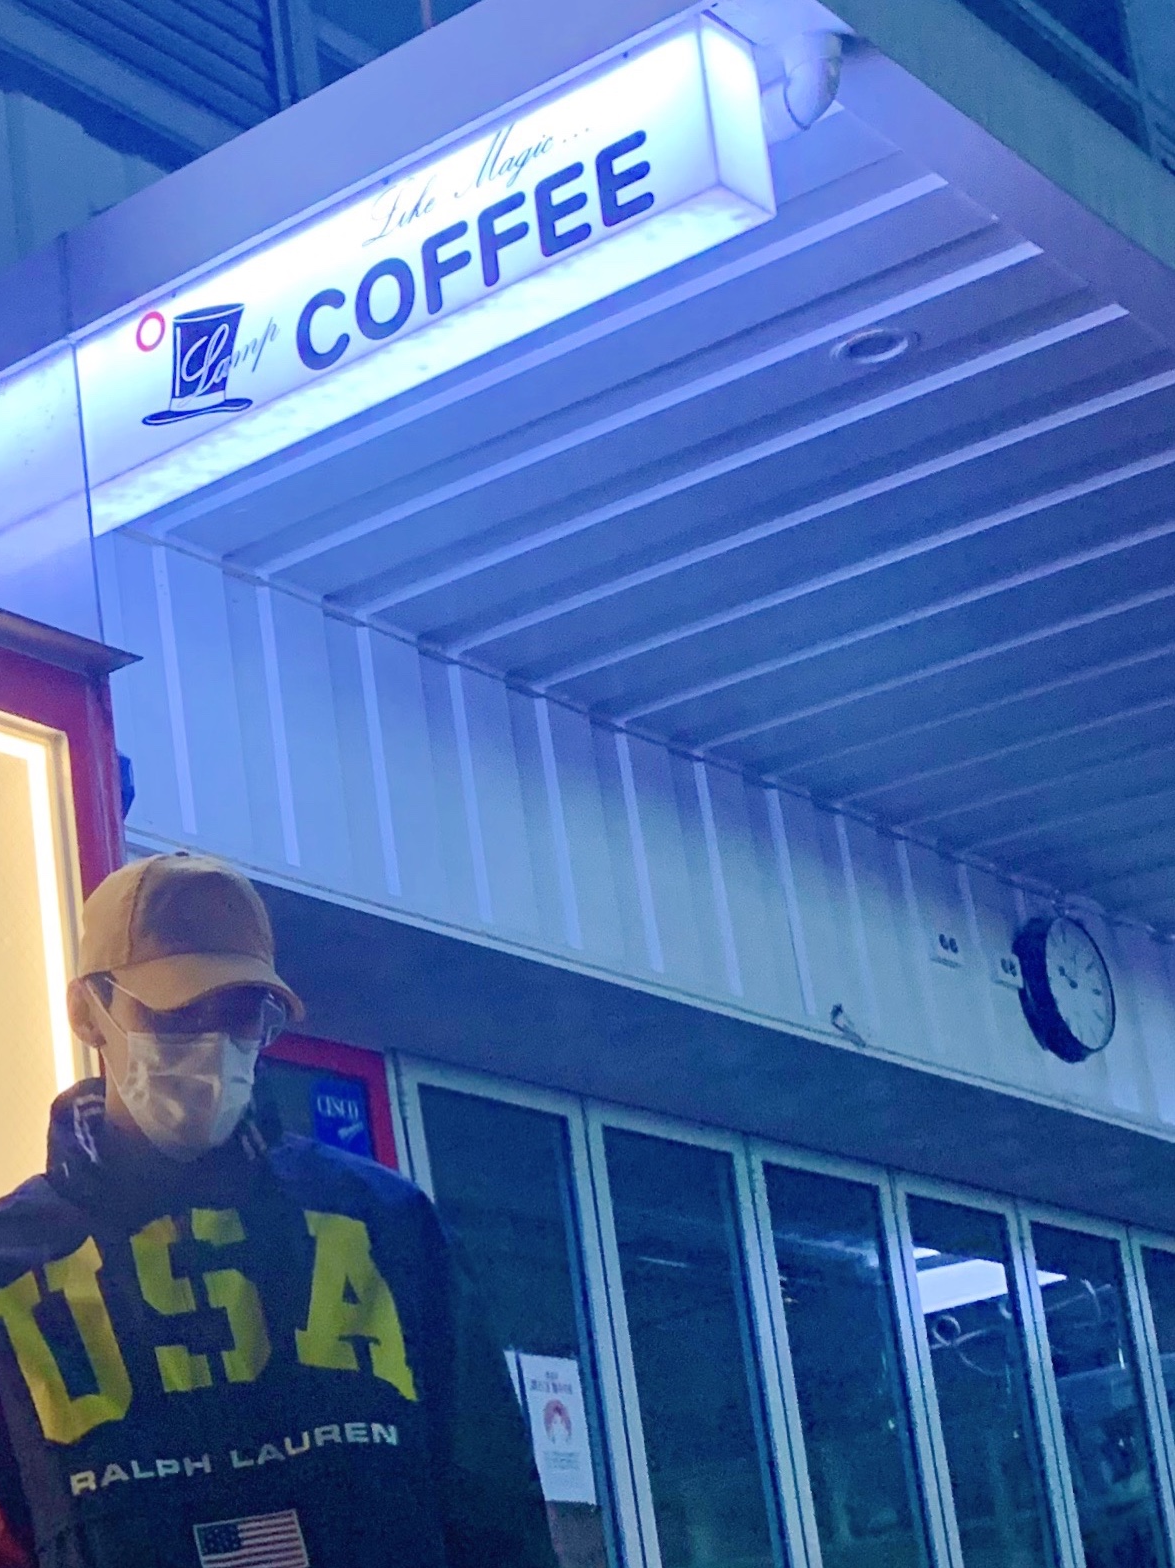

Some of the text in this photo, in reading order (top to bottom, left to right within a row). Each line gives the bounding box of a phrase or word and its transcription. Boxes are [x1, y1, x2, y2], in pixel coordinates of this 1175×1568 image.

[177, 130, 654, 408] Lamp COFFEE
[70, 1422, 399, 1496] RALPH LAUREN
